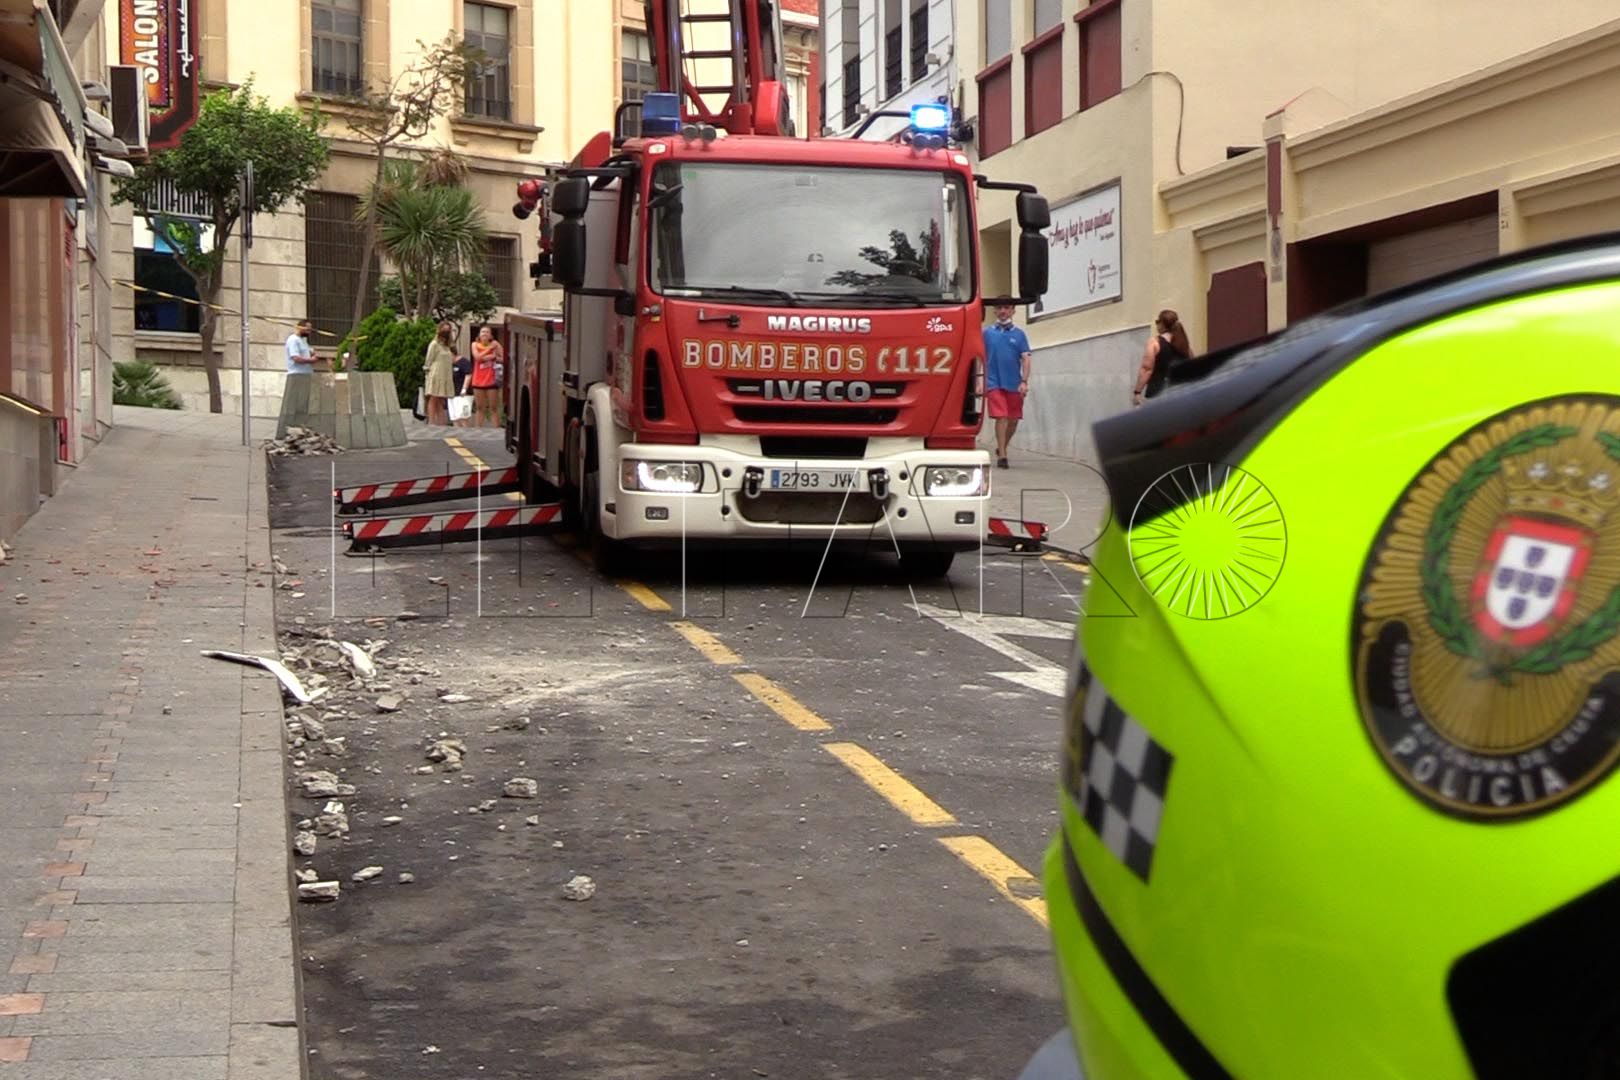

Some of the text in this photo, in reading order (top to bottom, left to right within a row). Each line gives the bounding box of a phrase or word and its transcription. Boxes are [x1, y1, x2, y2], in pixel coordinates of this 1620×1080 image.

[767, 315, 872, 333] MAGIRUS
[683, 340, 952, 374] BOMBEROS 112
[763, 379, 871, 402] IVECO
[781, 472, 856, 489] 2793 JVK
[1391, 735, 1569, 807] POLICIA
